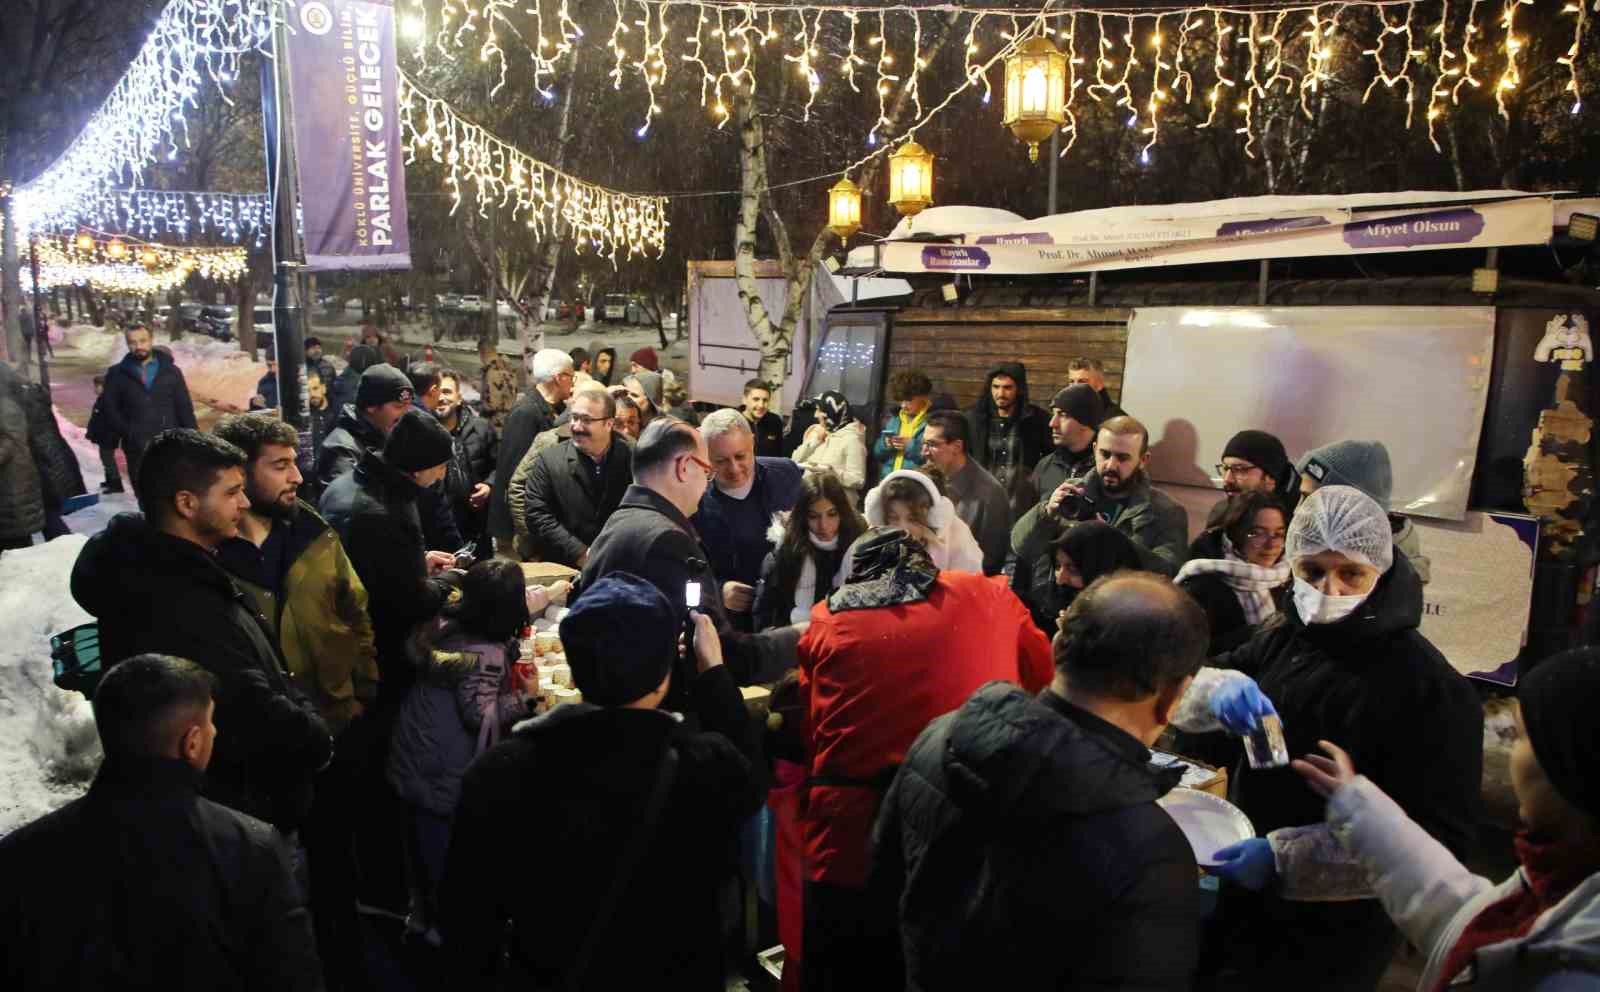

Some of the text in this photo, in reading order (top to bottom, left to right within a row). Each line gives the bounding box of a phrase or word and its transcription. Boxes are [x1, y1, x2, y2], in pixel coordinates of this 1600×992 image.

[355, 7, 392, 246] PARLAK GELECEK
[352, 202, 368, 246] KÖKLÜ
[1363, 220, 1460, 238] Afiyet Olsun
